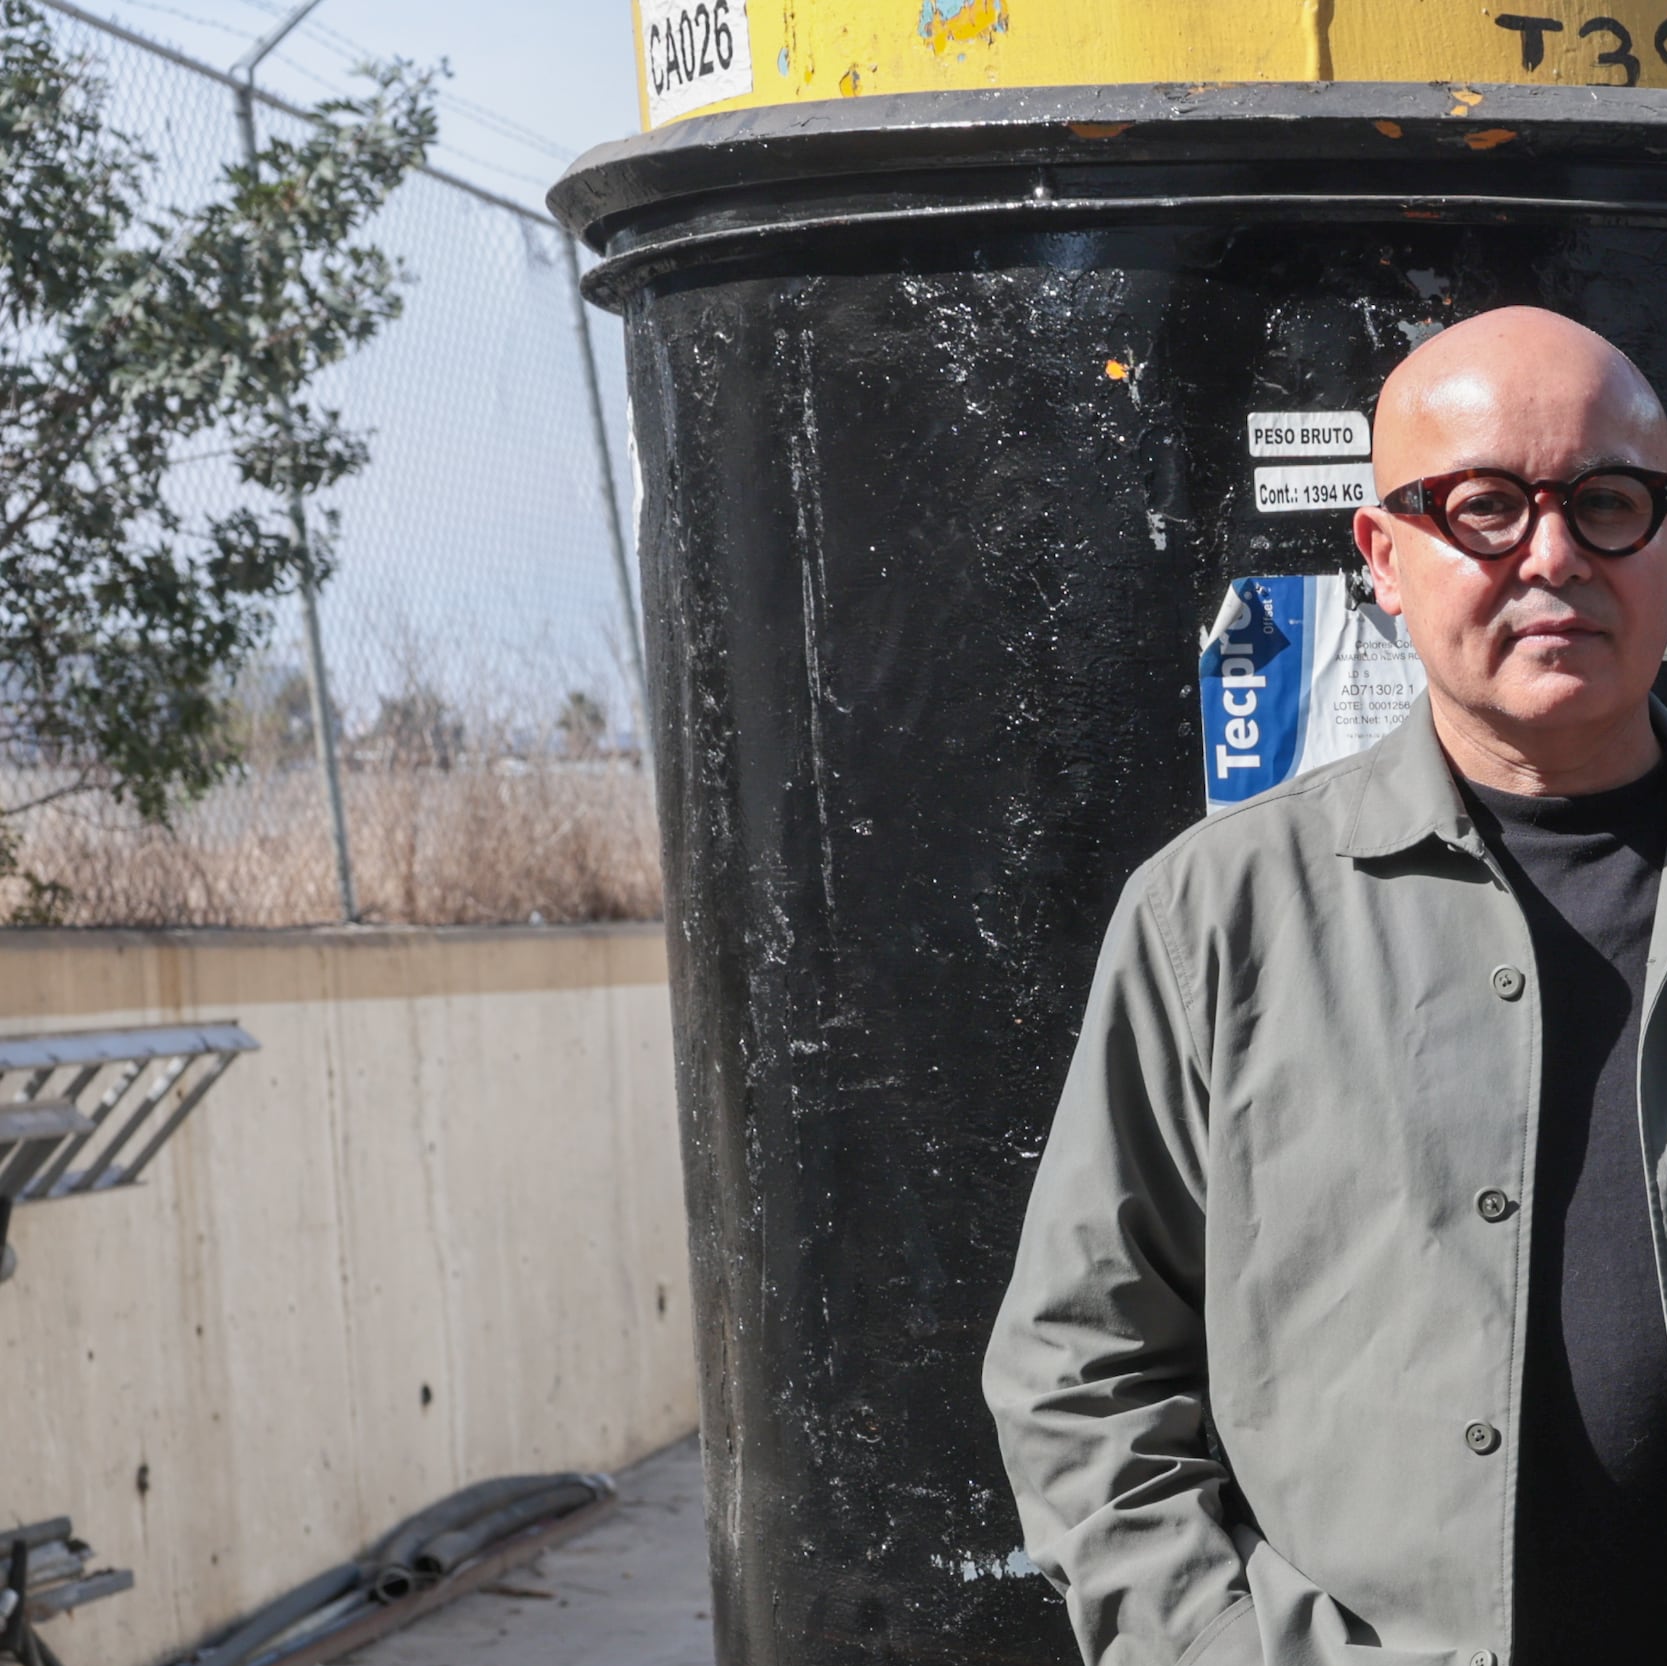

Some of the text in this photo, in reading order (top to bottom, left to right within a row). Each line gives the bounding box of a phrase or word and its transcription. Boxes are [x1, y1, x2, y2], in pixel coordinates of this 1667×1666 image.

[650, 0, 733, 96] CA026
[1254, 427, 1353, 445] PESO BRUTO
[1260, 483, 1363, 505] Cont.: 1394 KG
[1341, 684, 1404, 696] AD7130/2
